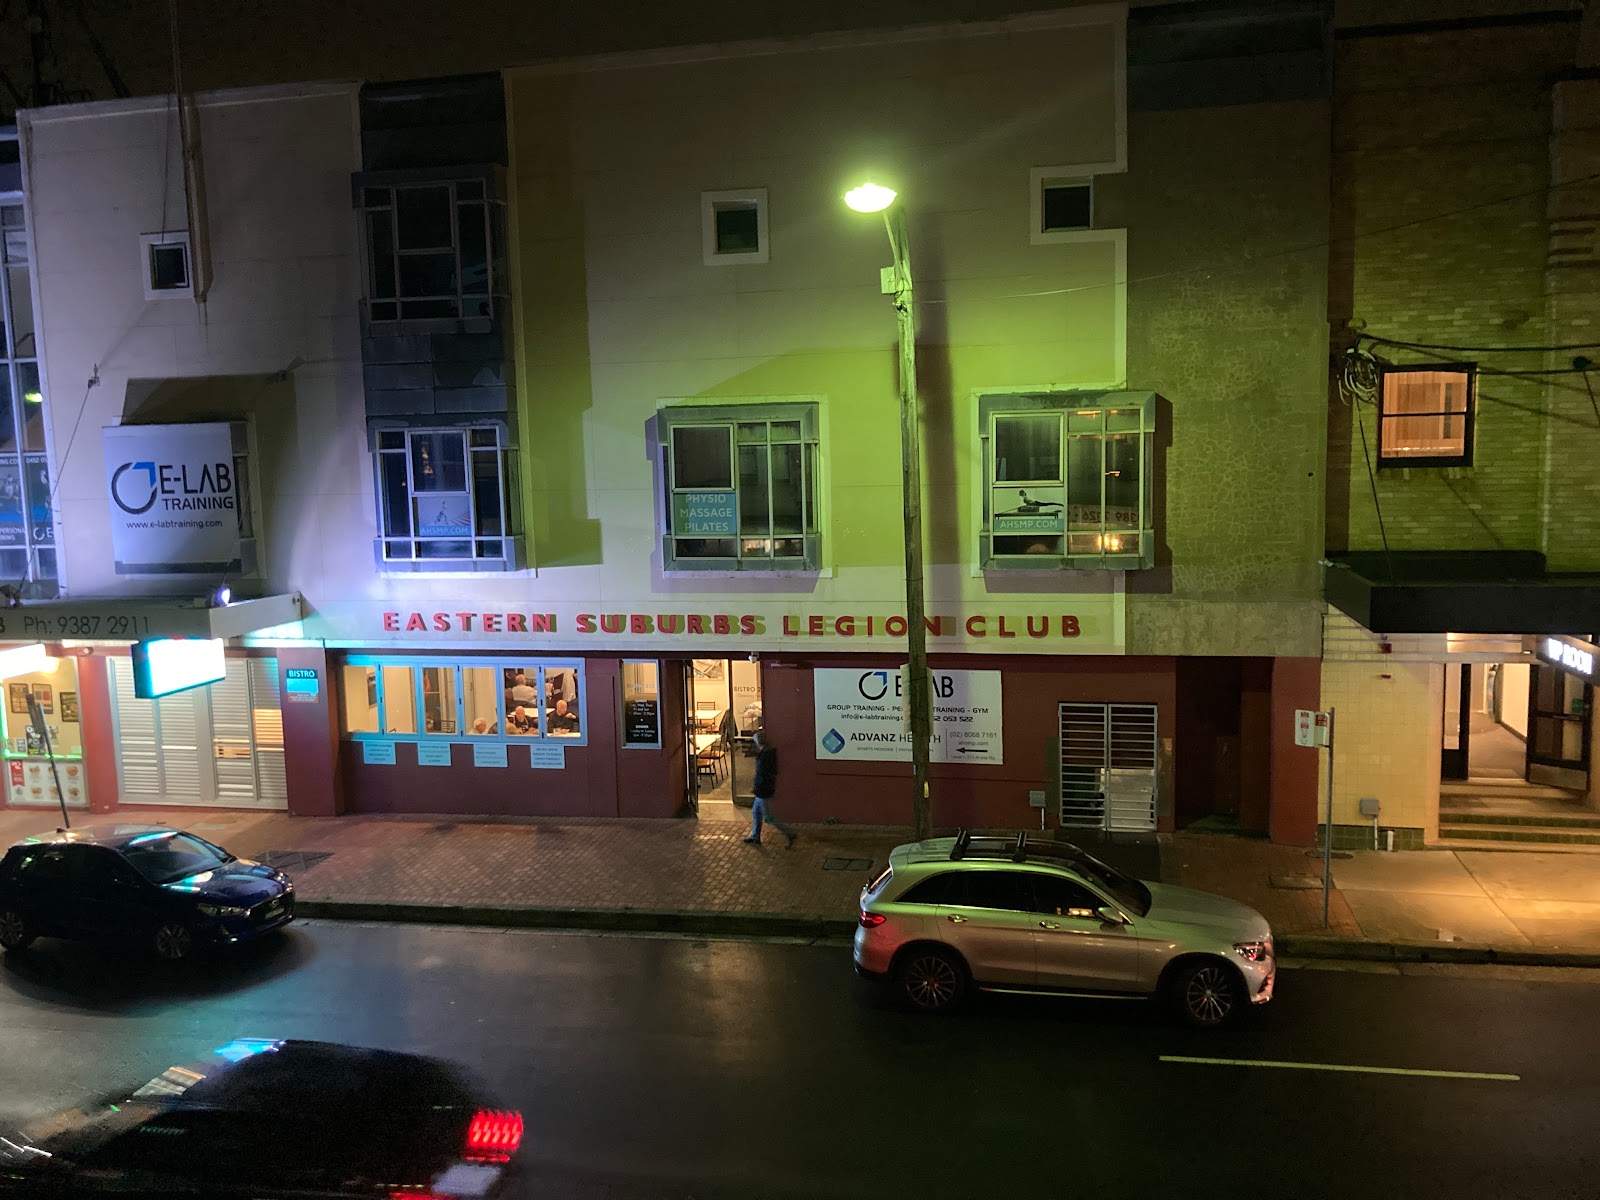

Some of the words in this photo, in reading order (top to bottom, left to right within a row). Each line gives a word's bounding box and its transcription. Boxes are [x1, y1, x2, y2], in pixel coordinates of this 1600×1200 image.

[159, 464, 232, 494] E-LAB
[162, 496, 234, 510] TRAINING
[686, 494, 726, 503] PHYSIO
[680, 508, 733, 517] MASSAGE
[126, 519, 223, 529] www.e-labtraining.com
[685, 522, 729, 532] PILATES
[1000, 520, 1058, 529] AHSMP.COM
[24, 616, 52, 634] Ph:
[57, 616, 100, 634] 9387
[107, 616, 149, 634] 2911
[383, 612, 553, 633] EASTERN
[576, 613, 758, 635] SUBURBS
[783, 615, 941, 637] LEGION
[966, 615, 1081, 638] CLUB
[288, 669, 316, 678] BISTRO
[841, 713, 904, 722] info@e-labtraining.c
[850, 732, 896, 742] ADVANZ
